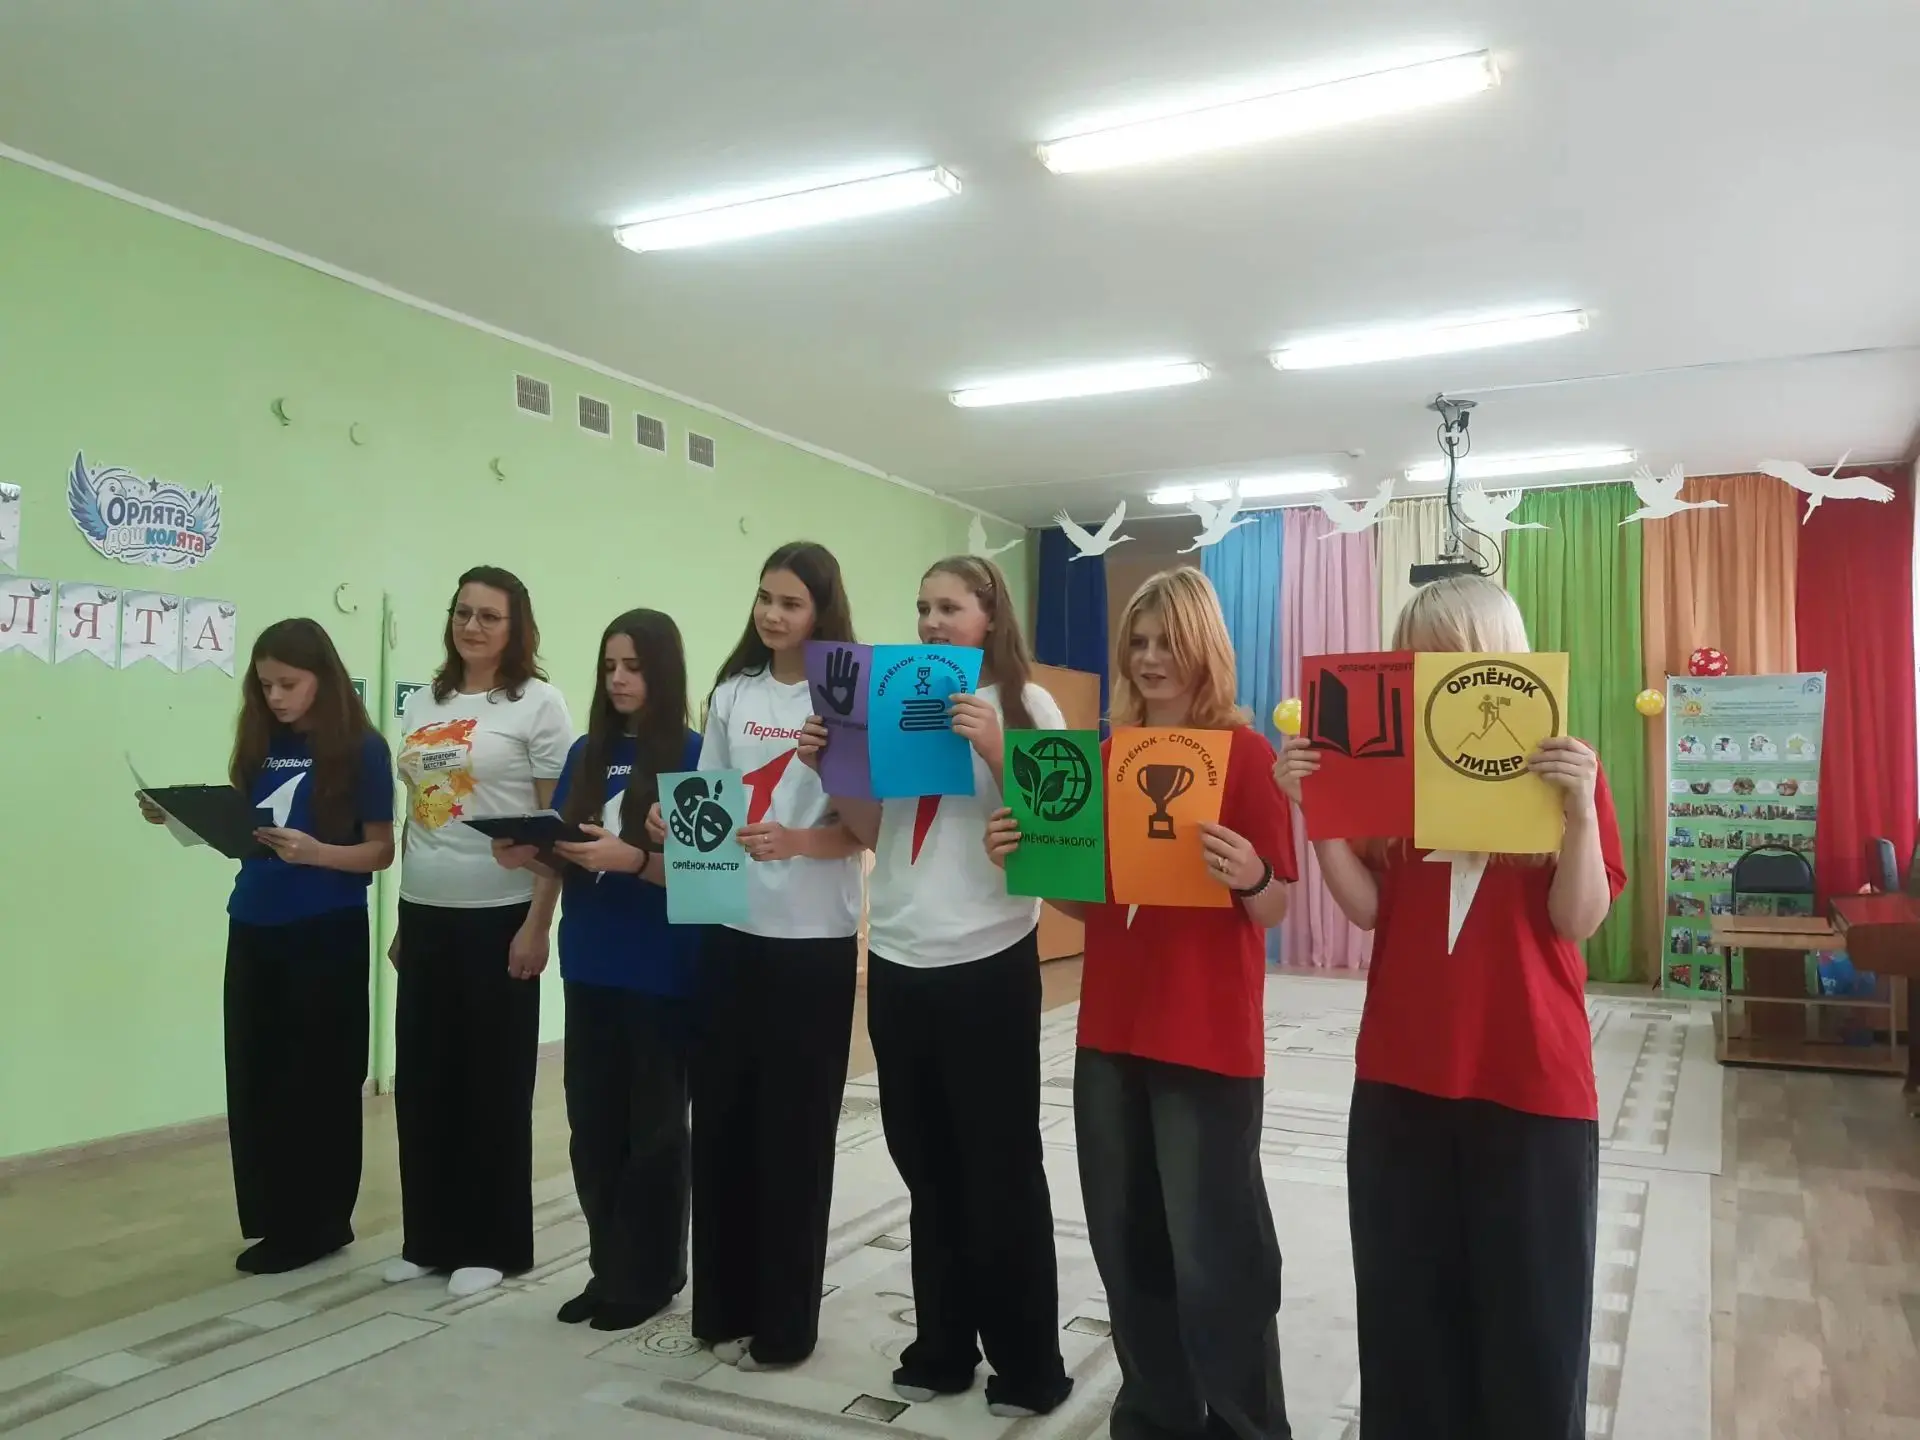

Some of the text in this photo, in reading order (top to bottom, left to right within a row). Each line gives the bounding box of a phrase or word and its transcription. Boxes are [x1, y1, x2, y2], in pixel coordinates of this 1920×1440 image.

[926, 653, 969, 694] ХРАНИТЕЛЬ
[1446, 667, 1540, 699] ОРЛЁНОК
[743, 721, 803, 741] Первые
[261, 756, 313, 771] Первые
[1116, 736, 1158, 783] ОРЛЁНОК
[1168, 733, 1218, 787] СПОРТСМЕН
[1454, 752, 1524, 776] ЛИДЕР
[672, 860, 740, 871] ОРЛЁНОК-МАСТЕР
